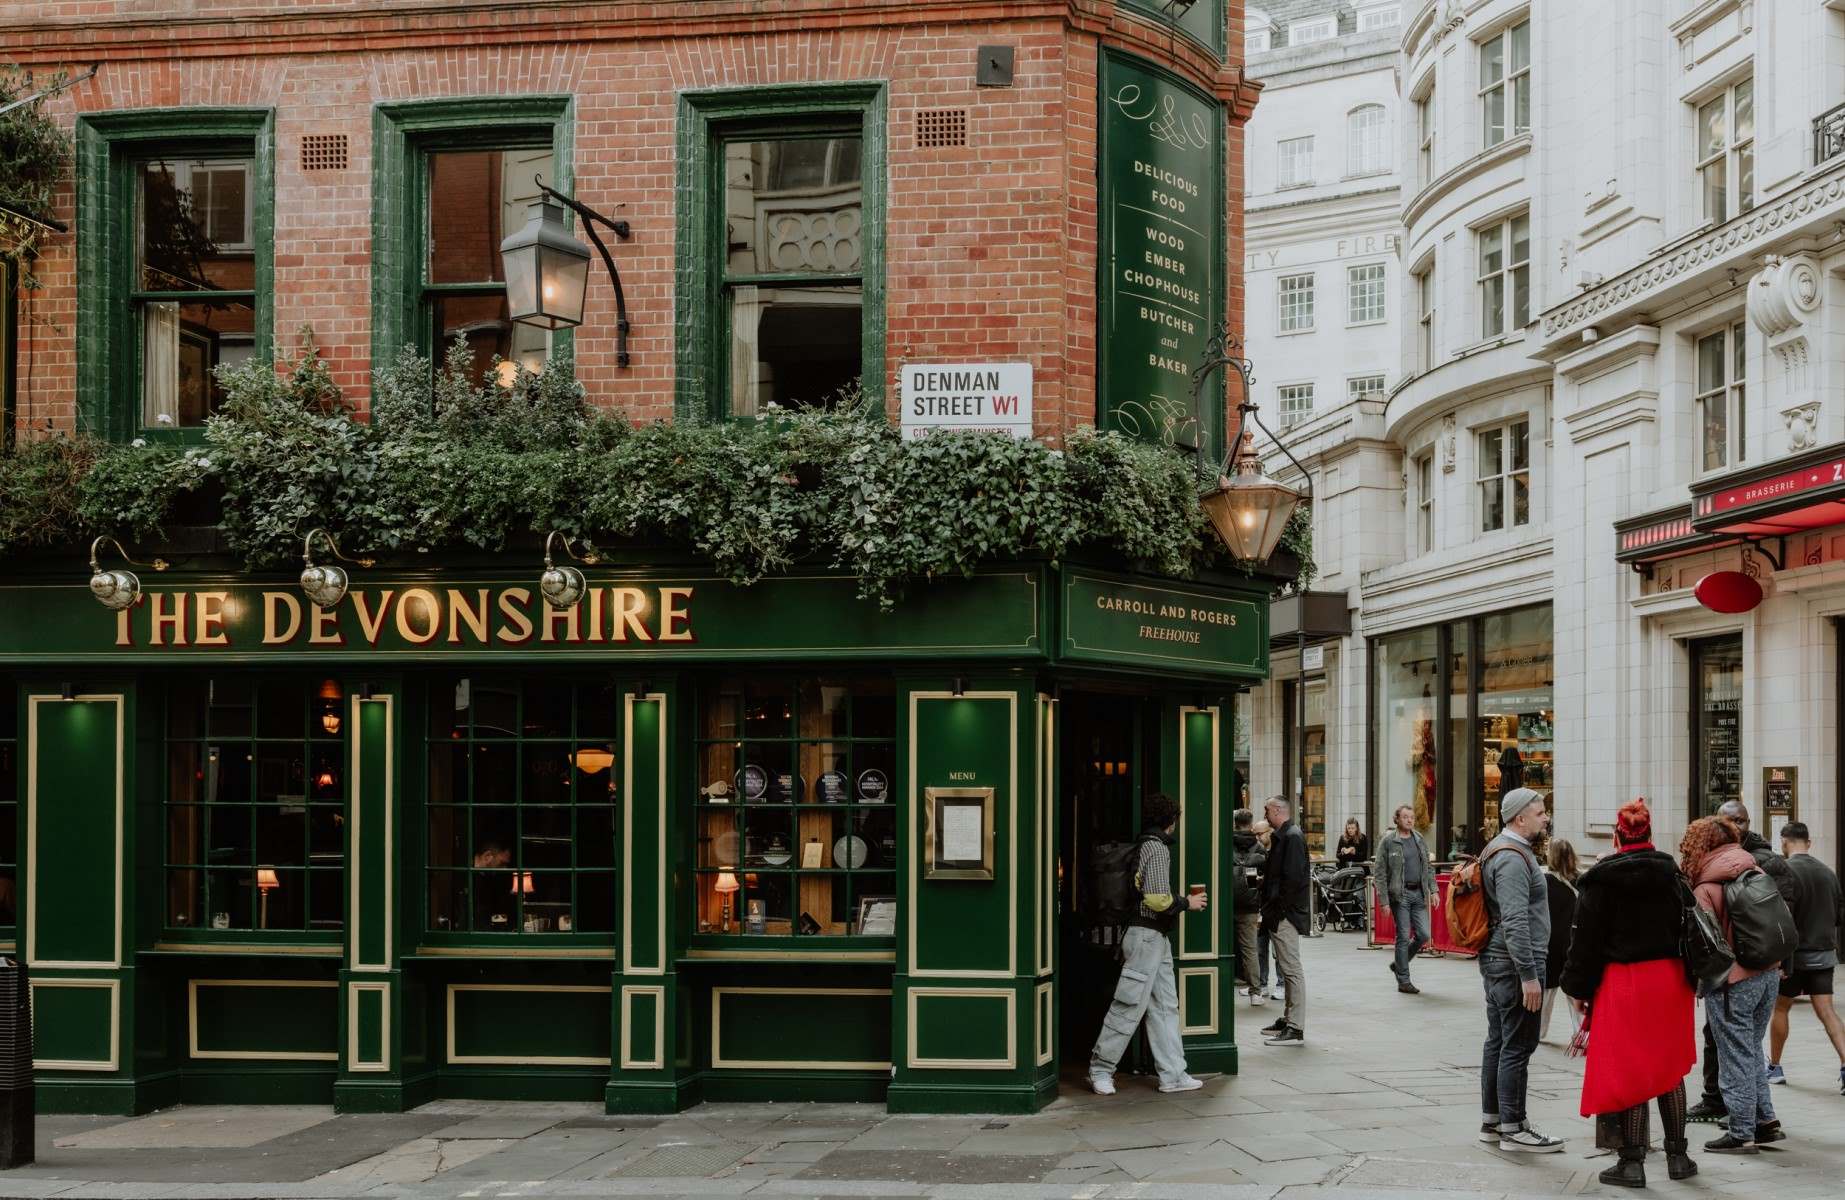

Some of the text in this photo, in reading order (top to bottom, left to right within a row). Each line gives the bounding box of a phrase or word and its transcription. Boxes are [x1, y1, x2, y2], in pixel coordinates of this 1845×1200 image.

[1134, 160, 1198, 197] DELICIOUS
[1152, 190, 1185, 213] FOOD
[1146, 227, 1184, 251] WOOD
[1145, 251, 1185, 275] EMBER
[1124, 269, 1200, 304] CHOPHOUSE
[1140, 307, 1194, 335] BUTCHER
[1160, 336, 1178, 349] and
[1149, 354, 1188, 375] BAKER
[913, 372, 999, 391] DENMAN
[914, 395, 1017, 416] STREET W1
[1746, 463, 1845, 500] BRASSERIE Z
[115, 587, 696, 647] THE DEVONSHIRE
[1096, 596, 1237, 627] CARROLL AND ROGERS
[1139, 625, 1201, 644] FREEHOUSE
[949, 772, 976, 780] MENU
